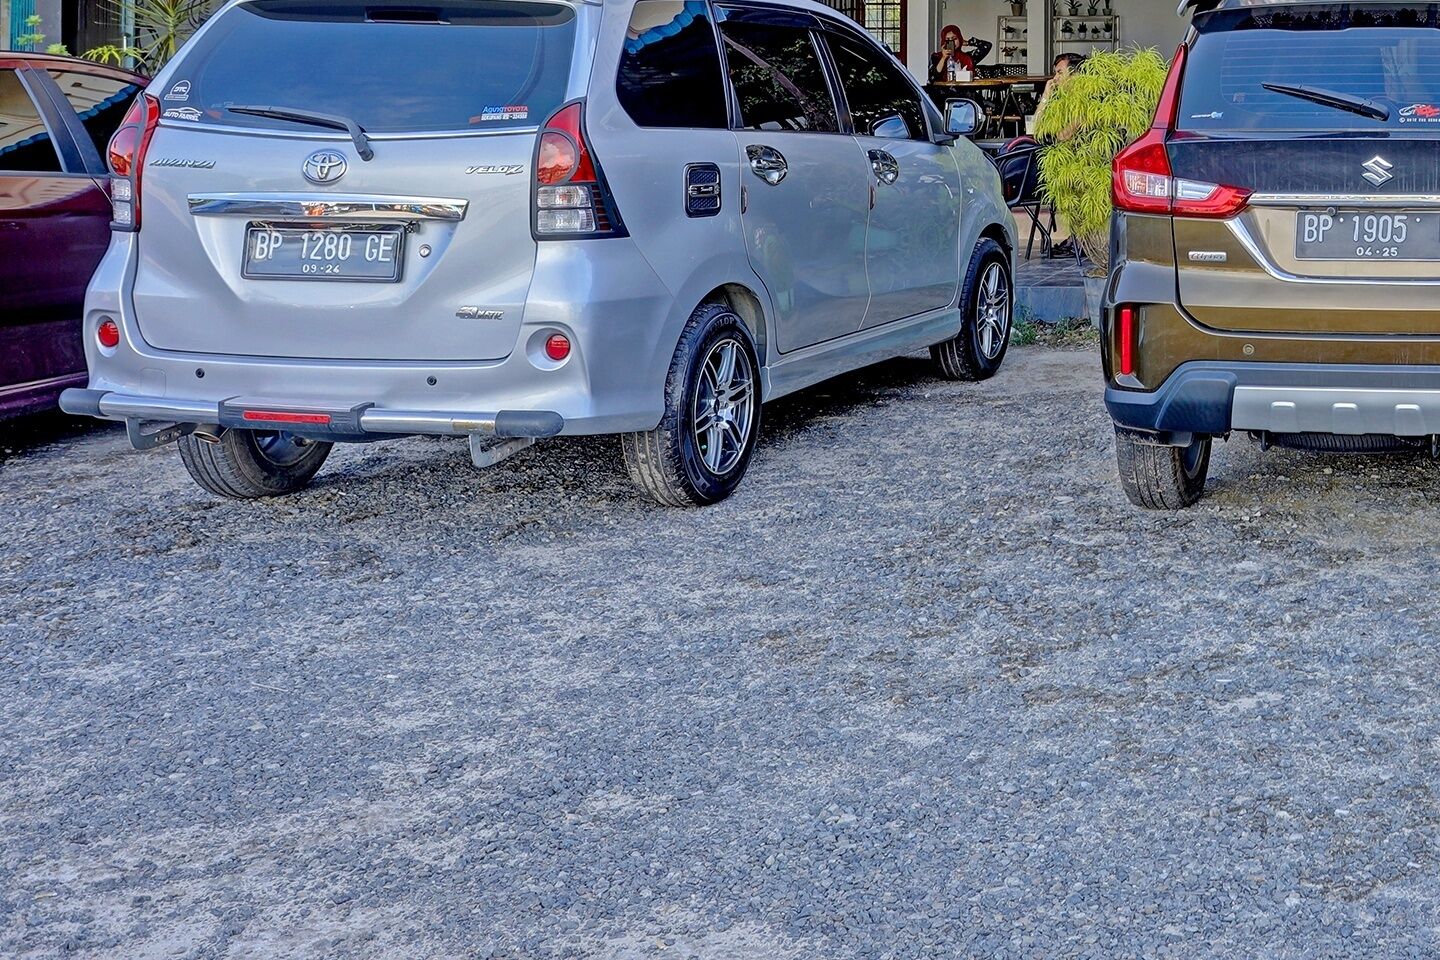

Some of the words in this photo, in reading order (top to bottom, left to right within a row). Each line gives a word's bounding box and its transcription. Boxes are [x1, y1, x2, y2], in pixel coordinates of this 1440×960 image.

[149, 159, 216, 169] AVANZA
[465, 165, 524, 175] VELOZ
[1303, 214, 1333, 242] BP
[1352, 215, 1407, 243] 1905
[255, 232, 283, 259] BP
[301, 233, 352, 260] 1280
[365, 235, 393, 262] GE
